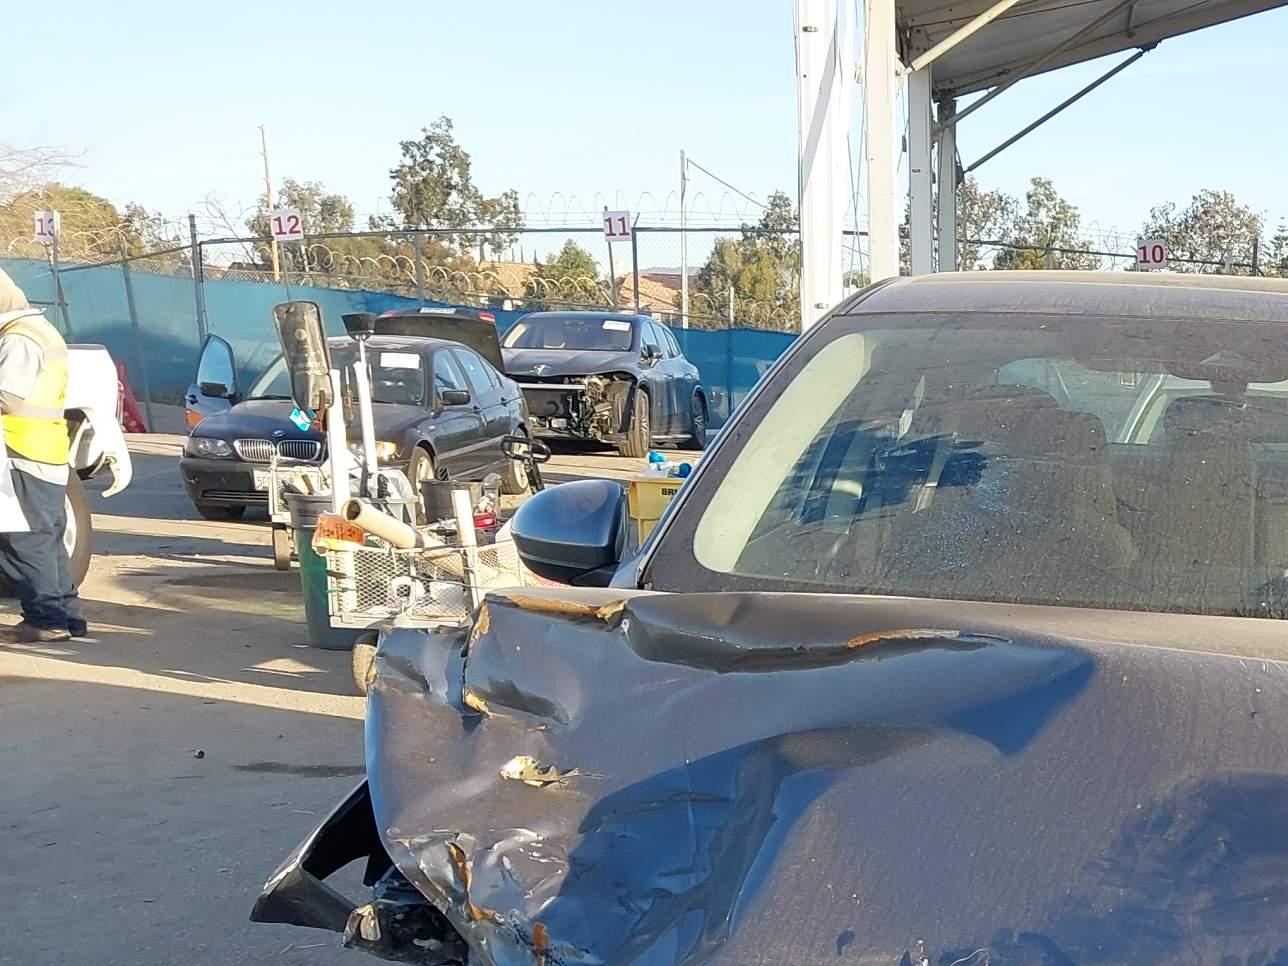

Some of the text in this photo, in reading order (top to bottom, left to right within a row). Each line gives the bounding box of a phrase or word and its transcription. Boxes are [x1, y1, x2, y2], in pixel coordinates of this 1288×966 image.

[273, 215, 301, 235] 12
[604, 216, 630, 236] 11
[1138, 244, 1164, 263] 10
